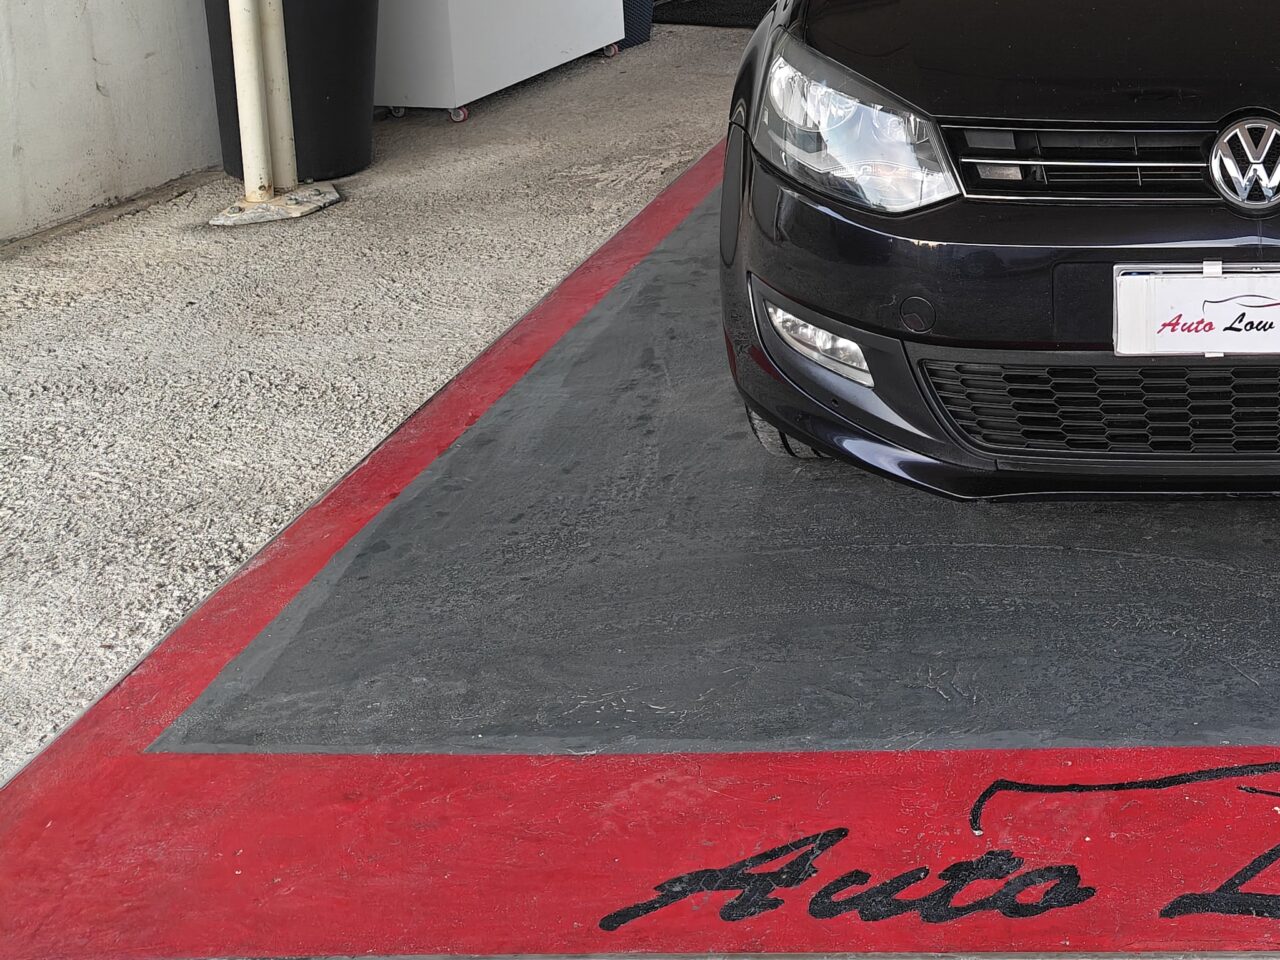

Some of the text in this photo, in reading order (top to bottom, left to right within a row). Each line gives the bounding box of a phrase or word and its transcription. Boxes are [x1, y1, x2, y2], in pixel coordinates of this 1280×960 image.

[1157, 313, 1215, 334] Auto
[1223, 311, 1275, 333] Low
[599, 827, 1097, 931] Auto
